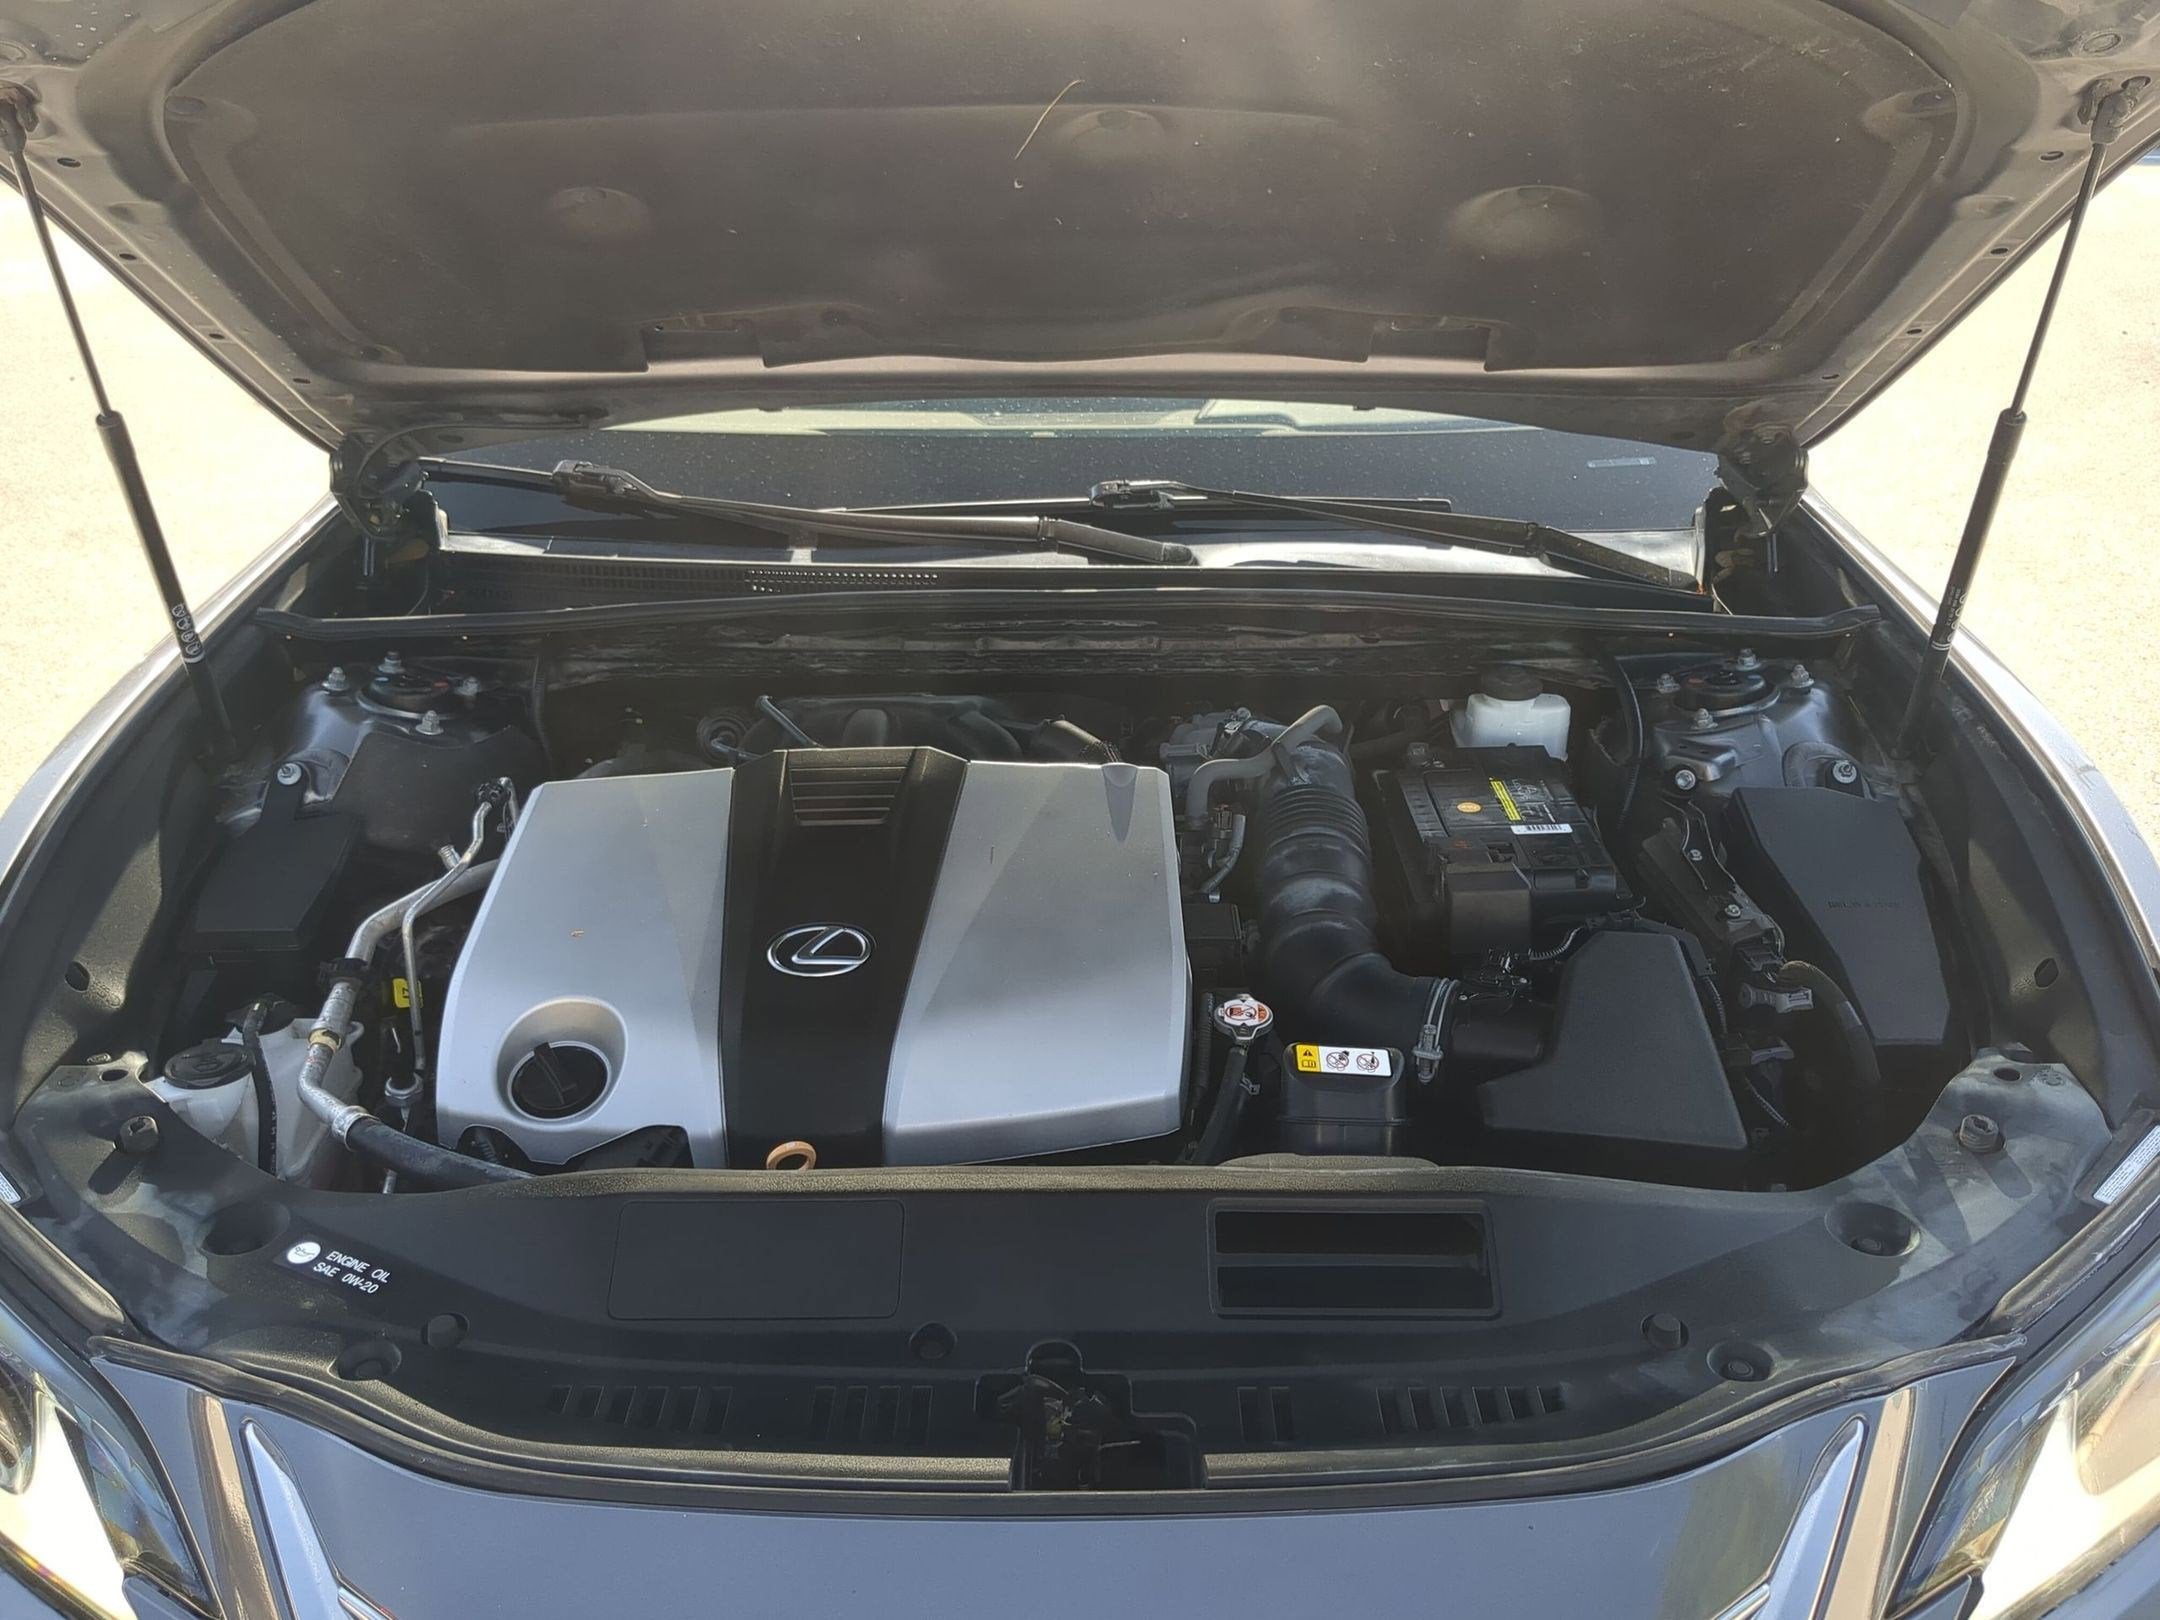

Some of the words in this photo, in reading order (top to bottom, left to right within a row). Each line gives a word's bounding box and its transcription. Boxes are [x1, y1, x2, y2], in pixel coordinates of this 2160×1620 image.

[313, 1261, 340, 1278] SAE
[341, 1272, 379, 1294] 0W-20
[325, 1250, 371, 1273] ENGINE
[370, 1268, 391, 1283] OIL
